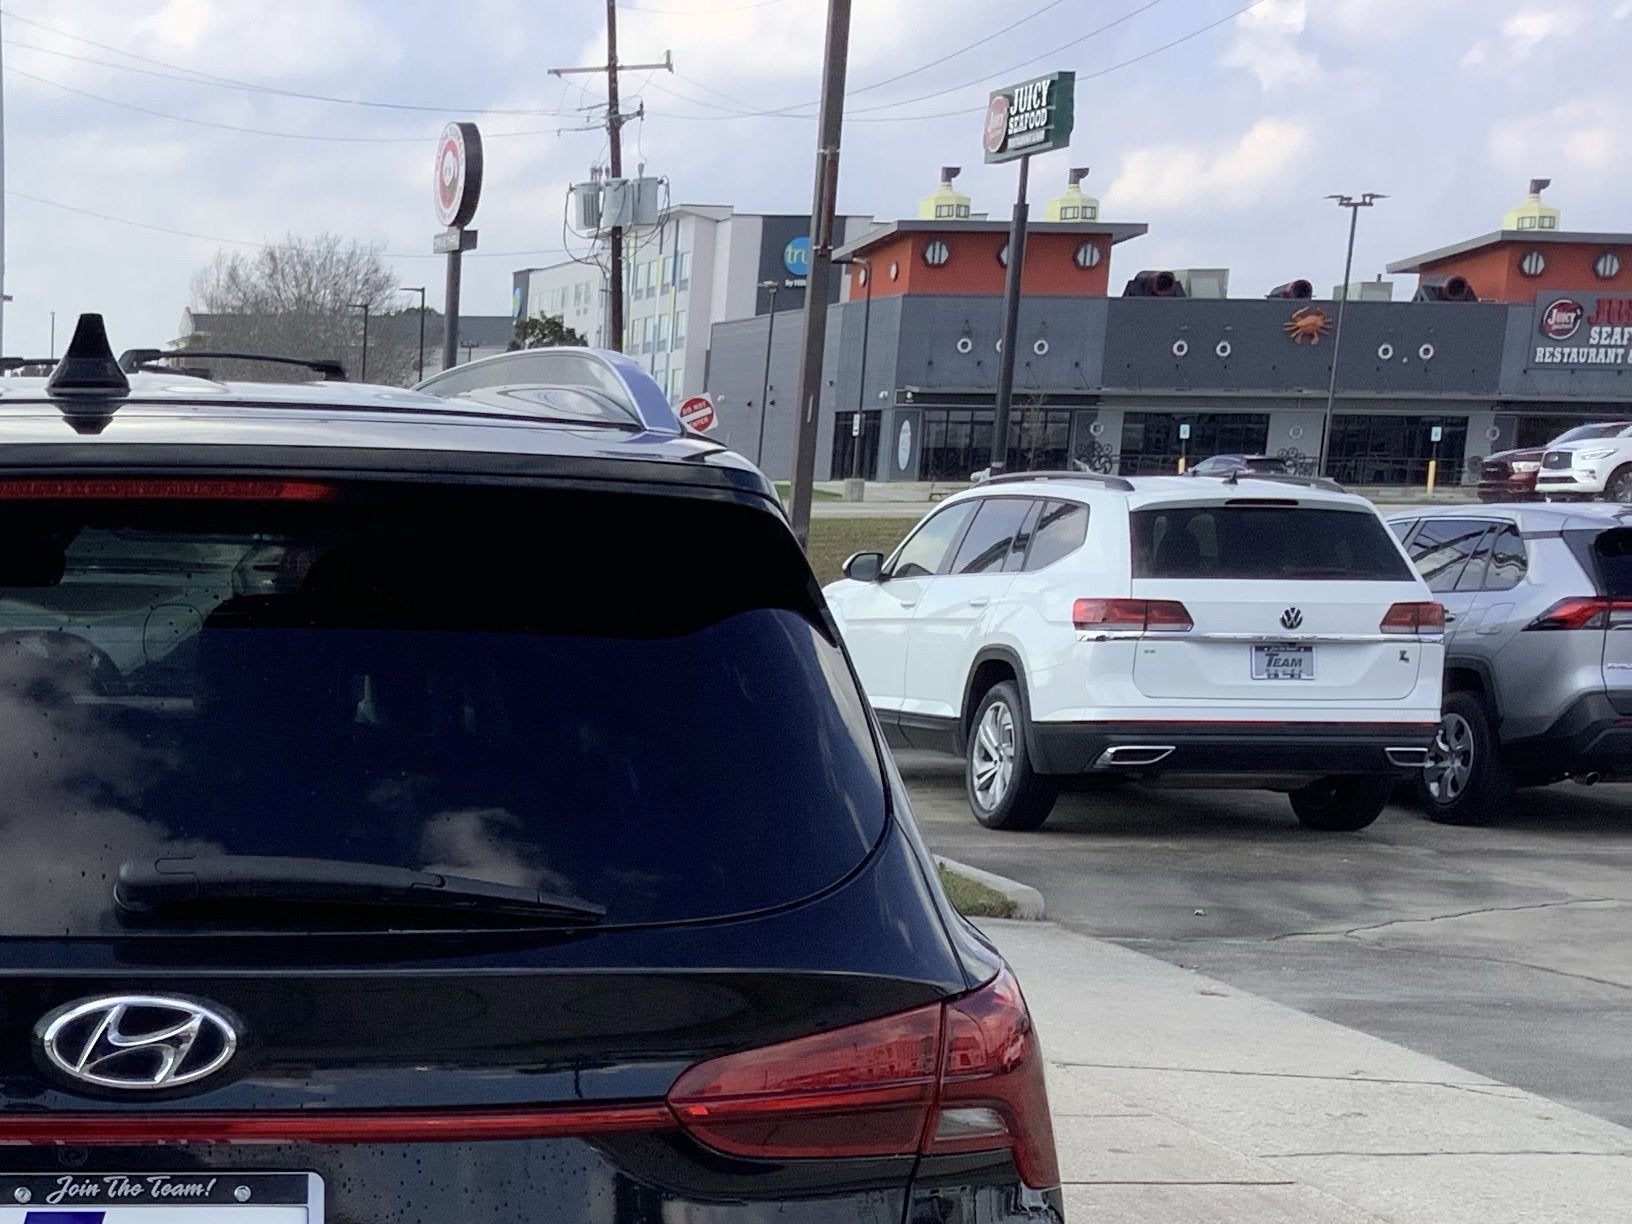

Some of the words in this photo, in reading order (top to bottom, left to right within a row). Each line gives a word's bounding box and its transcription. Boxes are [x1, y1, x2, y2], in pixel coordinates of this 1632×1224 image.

[1010, 80, 1051, 115] JUICY
[1008, 108, 1048, 135] SEAFOOD
[1535, 346, 1625, 364] RESTAURANT
[1265, 653, 1303, 667] TEAM
[45, 1175, 101, 1204] Join
[103, 1176, 145, 1198] The
[146, 1176, 217, 1197] Team!
